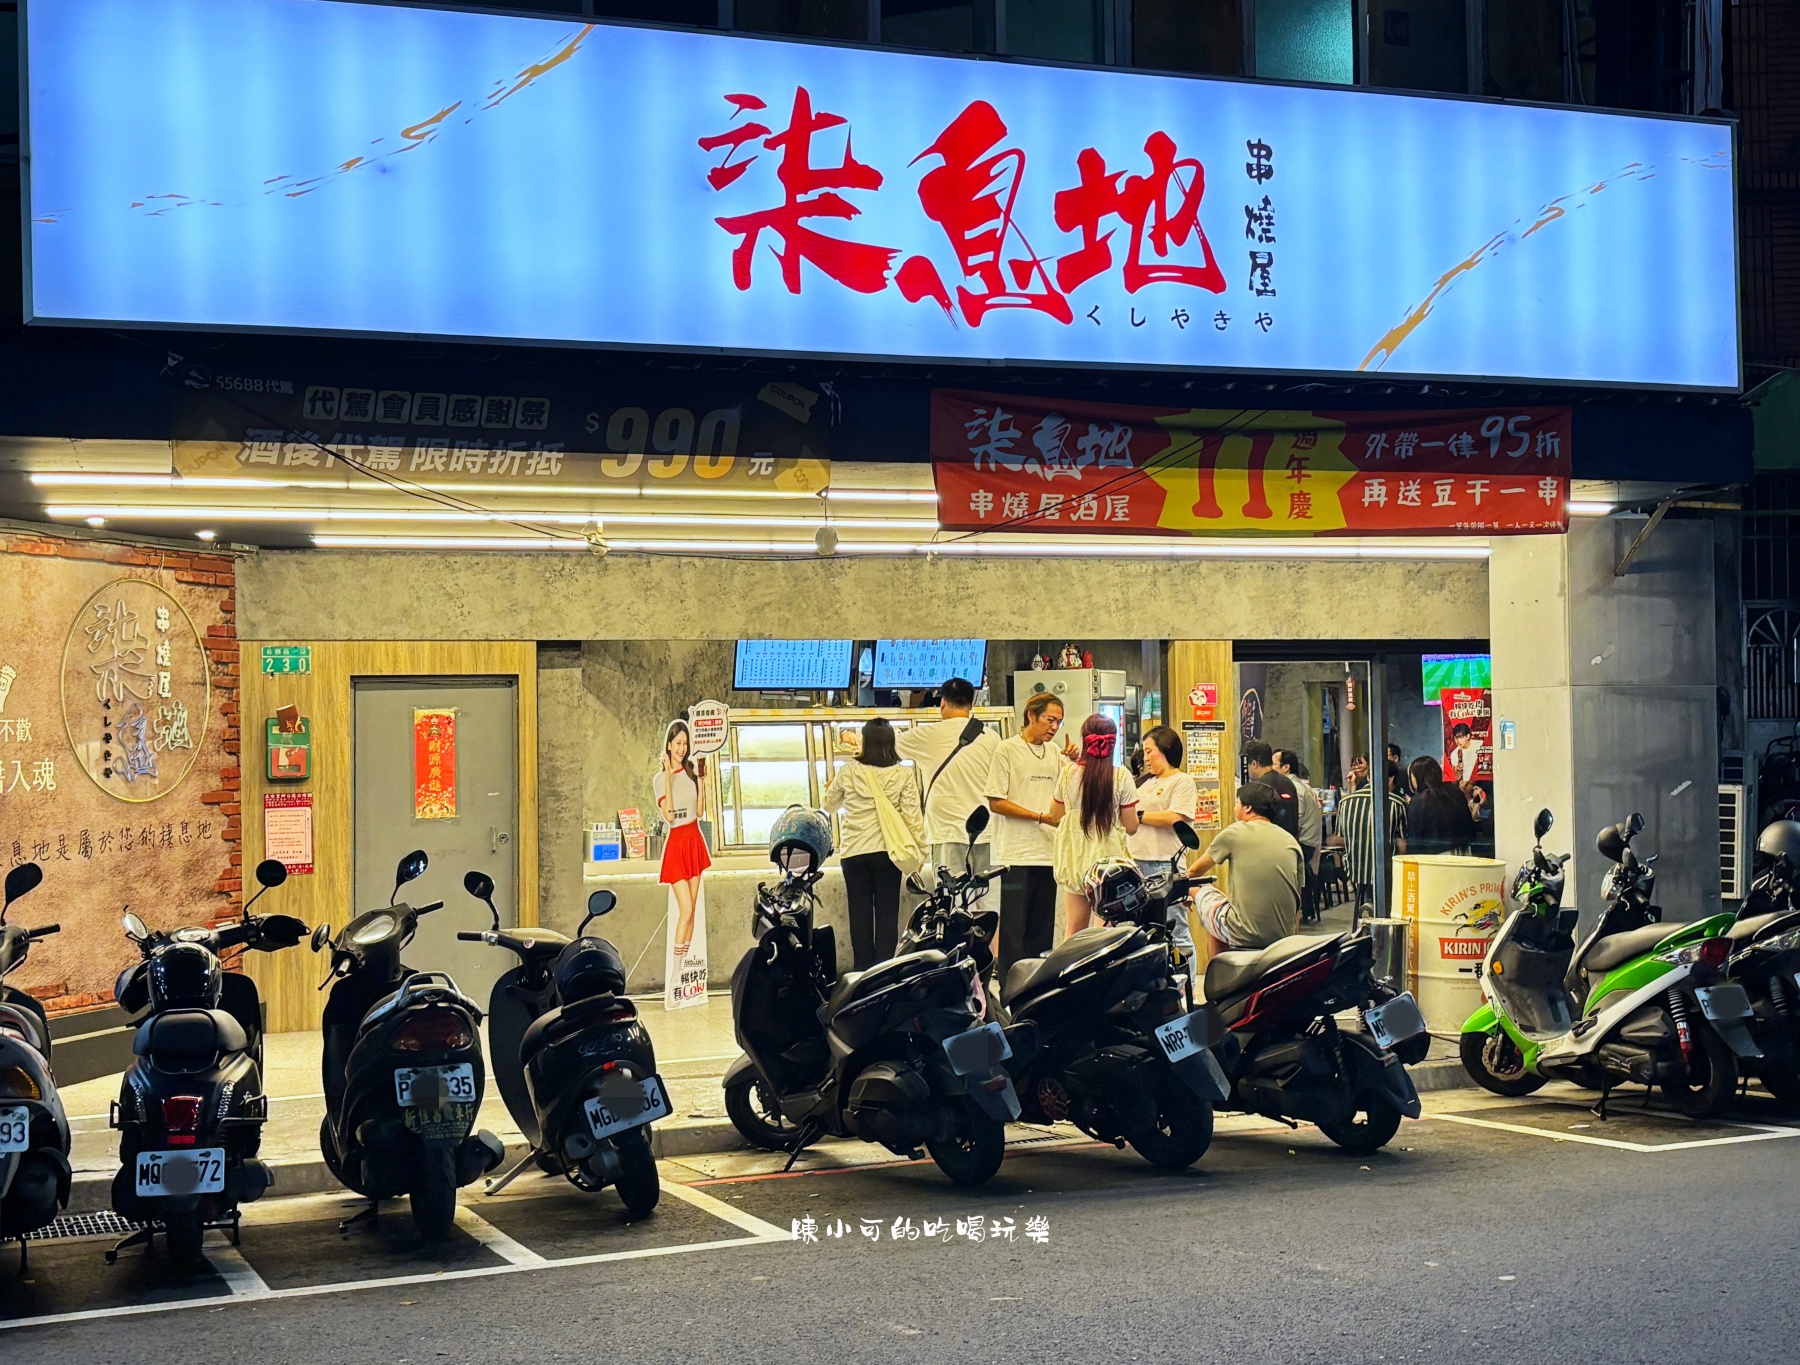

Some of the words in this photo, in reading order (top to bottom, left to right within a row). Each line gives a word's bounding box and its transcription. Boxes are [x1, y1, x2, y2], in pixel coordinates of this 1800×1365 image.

[698, 85, 1226, 330] 柒息地
[1244, 138, 1277, 297] 串燒屋
[1087, 306, 1273, 333] くしやきや
[306, 388, 549, 428] 代駕會員感謝祭
[239, 427, 404, 472] 酒後代駕
[409, 435, 566, 477] 限時折抵
[964, 406, 1134, 482] 柒息地
[1285, 430, 1319, 520] 週年慶
[1361, 477, 1558, 508] 再送豆干一串
[969, 488, 1131, 522] 串燒居酒屋
[155, 606, 172, 698] 串燒屋
[266, 657, 307, 672] 230
[0, 757, 57, 794] 入魂
[0, 820, 213, 868] 息地是屬於您的棲息地
[1440, 885, 1477, 916] KIRIN'S
[1443, 941, 1481, 955] KIRIN
